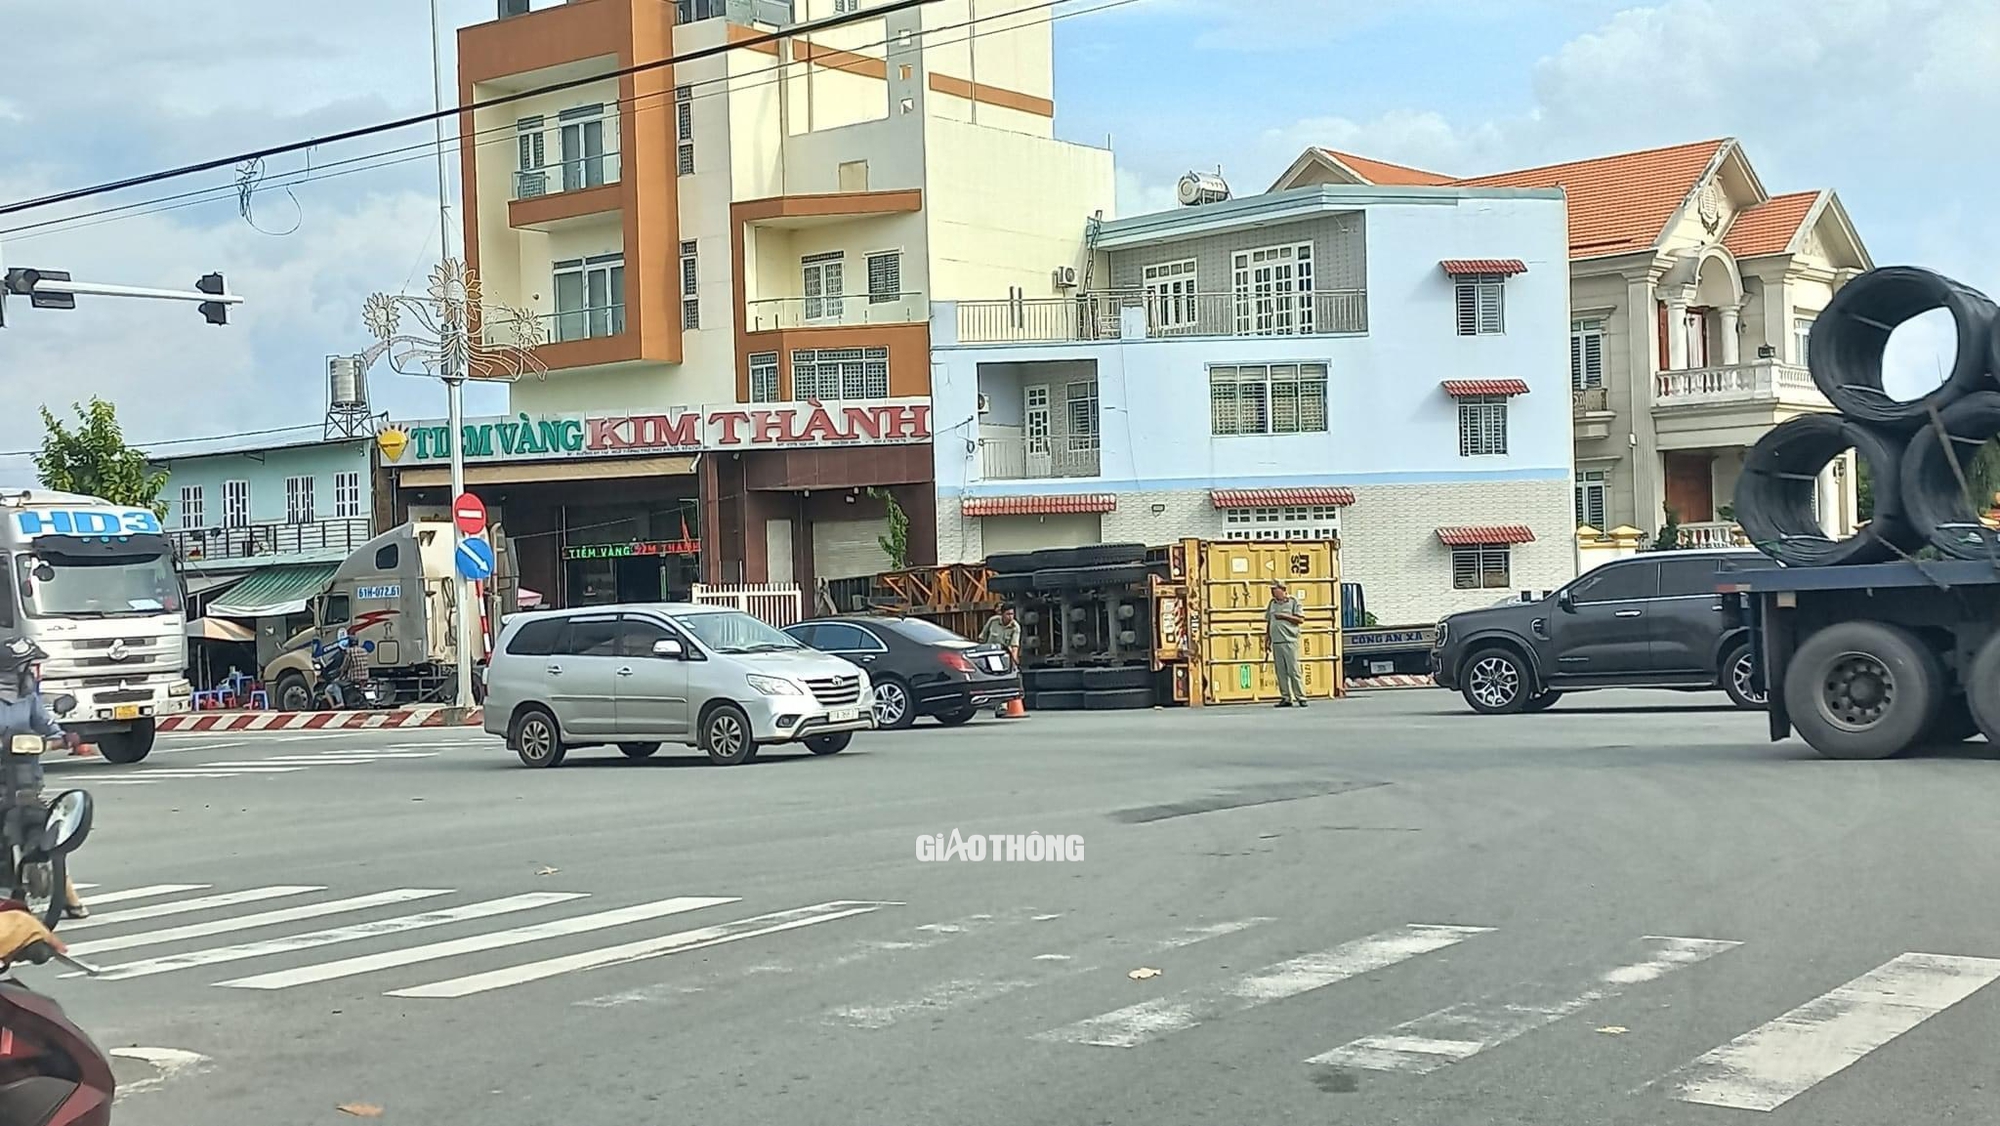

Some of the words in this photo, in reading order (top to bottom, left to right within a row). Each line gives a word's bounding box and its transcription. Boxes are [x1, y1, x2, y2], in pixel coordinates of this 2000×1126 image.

[495, 412, 584, 455] VÀNG
[586, 414, 702, 451] KIM
[708, 398, 931, 445] THÀNH
